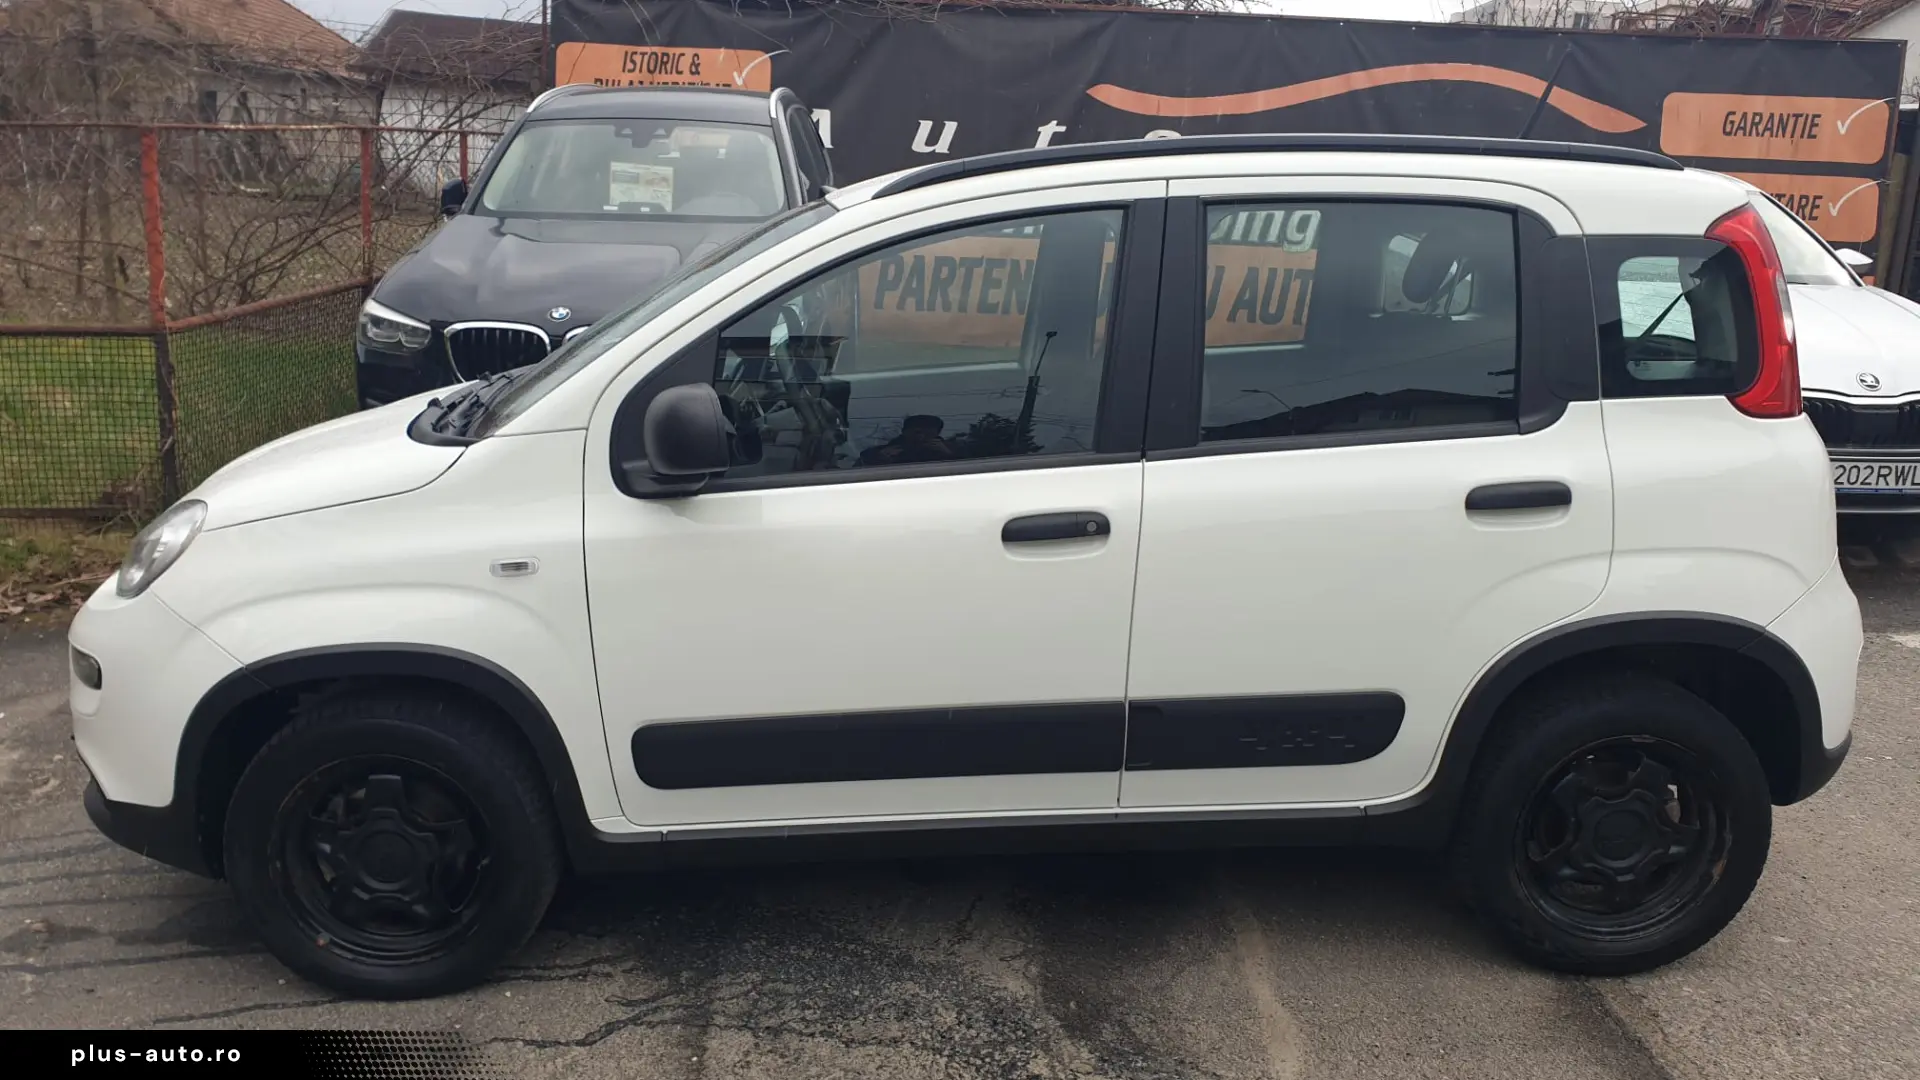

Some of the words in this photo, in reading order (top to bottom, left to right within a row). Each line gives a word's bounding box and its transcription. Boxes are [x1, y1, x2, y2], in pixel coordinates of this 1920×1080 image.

[622, 50, 685, 75] ISTORIC
[689, 52, 701, 75] &
[874, 255, 1036, 315] PARTEN
[1833, 464, 1920, 486] 202RWL
